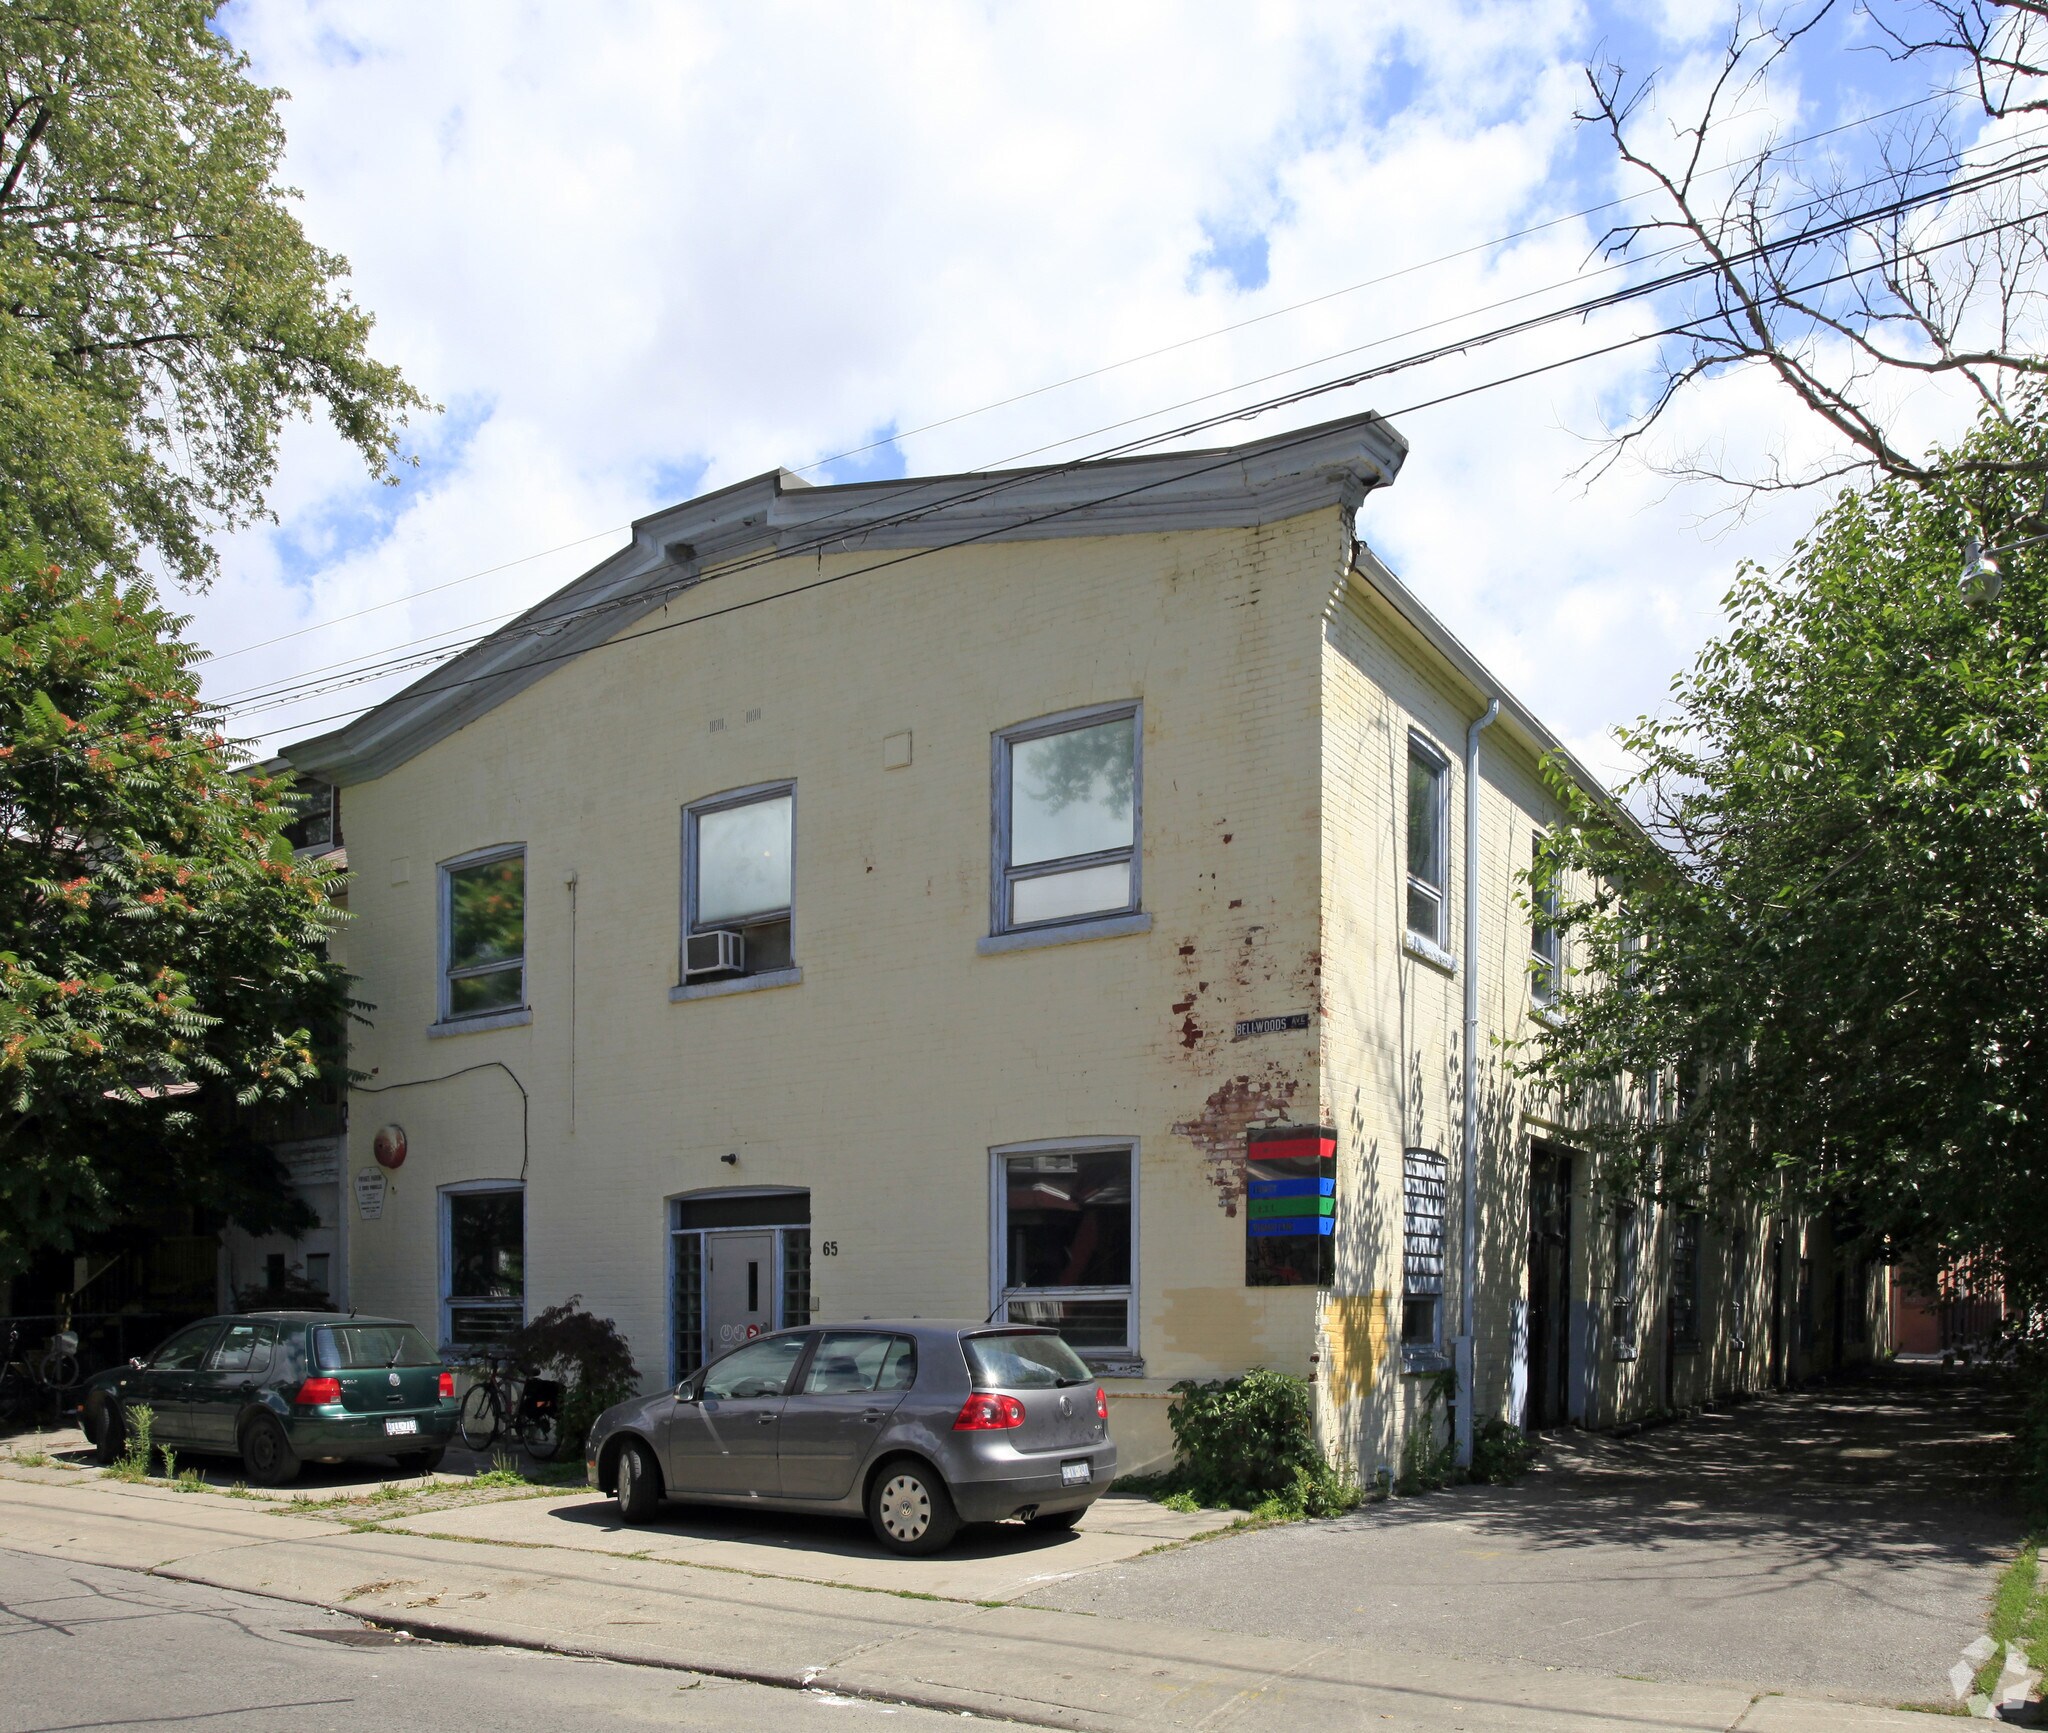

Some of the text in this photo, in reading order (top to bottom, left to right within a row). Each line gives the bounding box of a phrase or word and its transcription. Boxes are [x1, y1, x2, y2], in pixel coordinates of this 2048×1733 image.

[1236, 1015, 1306, 1036] BELLWOODS AVE
[822, 1240, 838, 1257] 65
